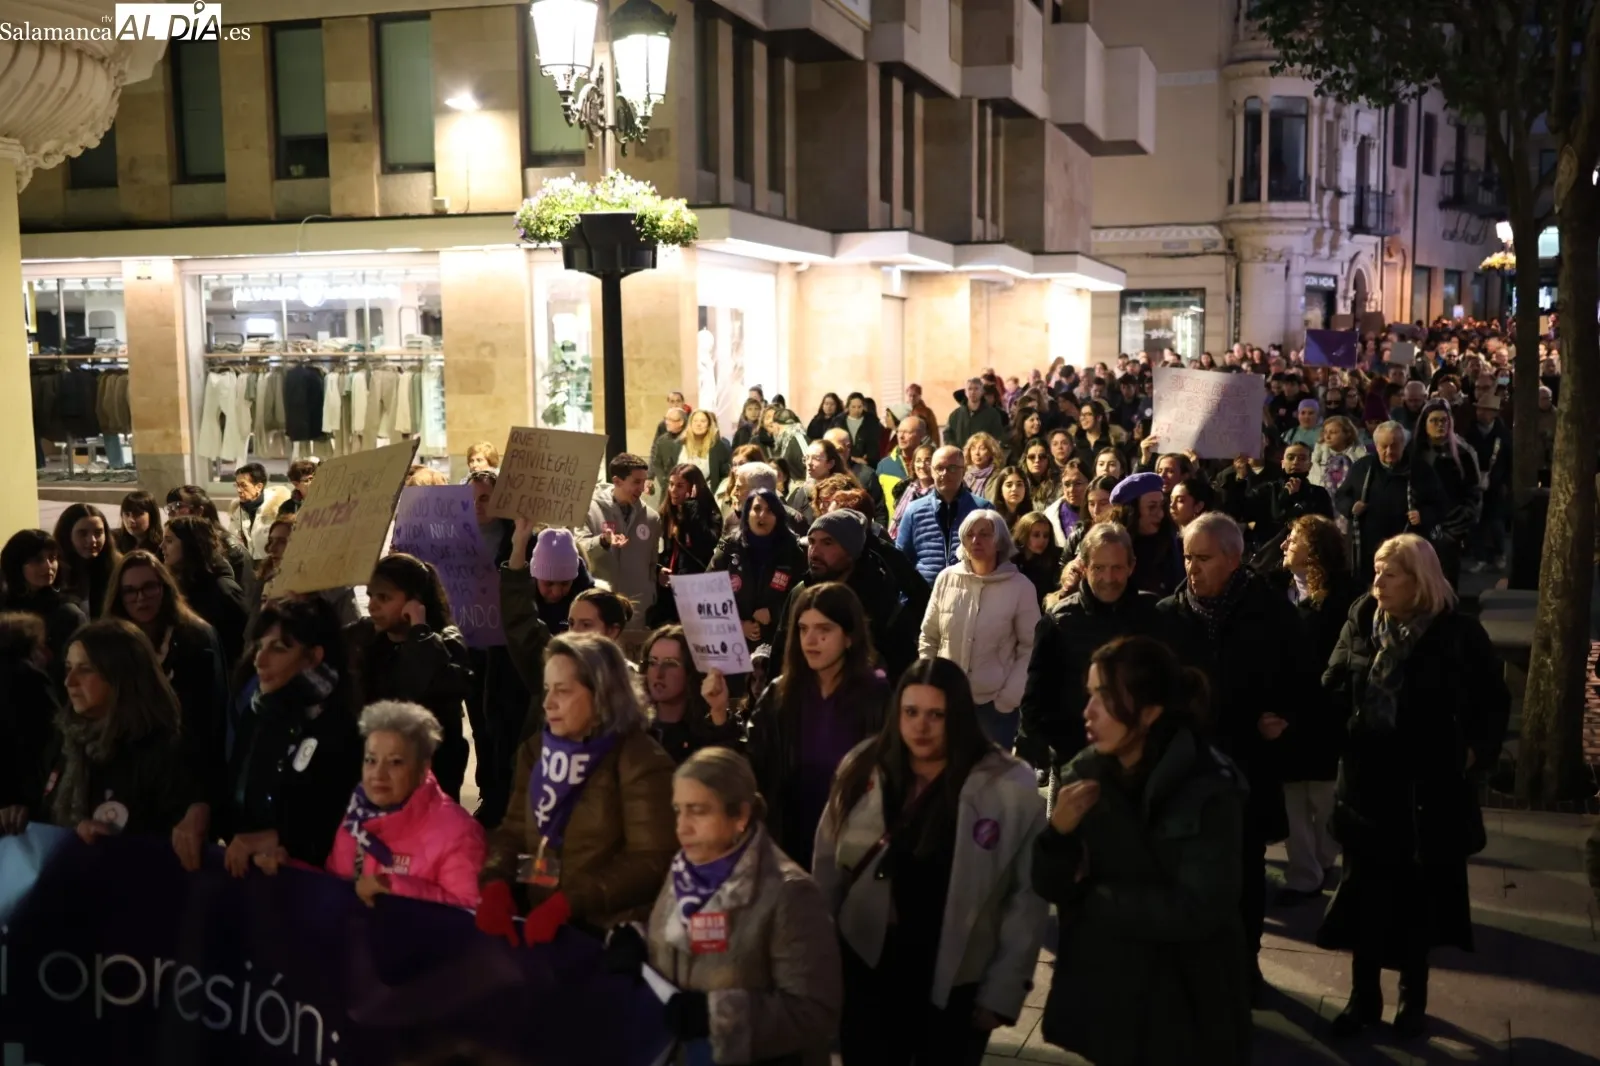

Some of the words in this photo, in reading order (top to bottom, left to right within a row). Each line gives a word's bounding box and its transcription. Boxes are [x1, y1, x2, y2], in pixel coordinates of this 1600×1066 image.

[510, 430, 536, 446] QUE
[538, 433, 551, 449] EL
[508, 448, 579, 477] PRIVILEGIO
[504, 473, 525, 491] NO
[530, 476, 547, 492] TE
[547, 476, 587, 502] NUBLE
[495, 492, 513, 510] LA
[429, 520, 461, 541] NIÑA
